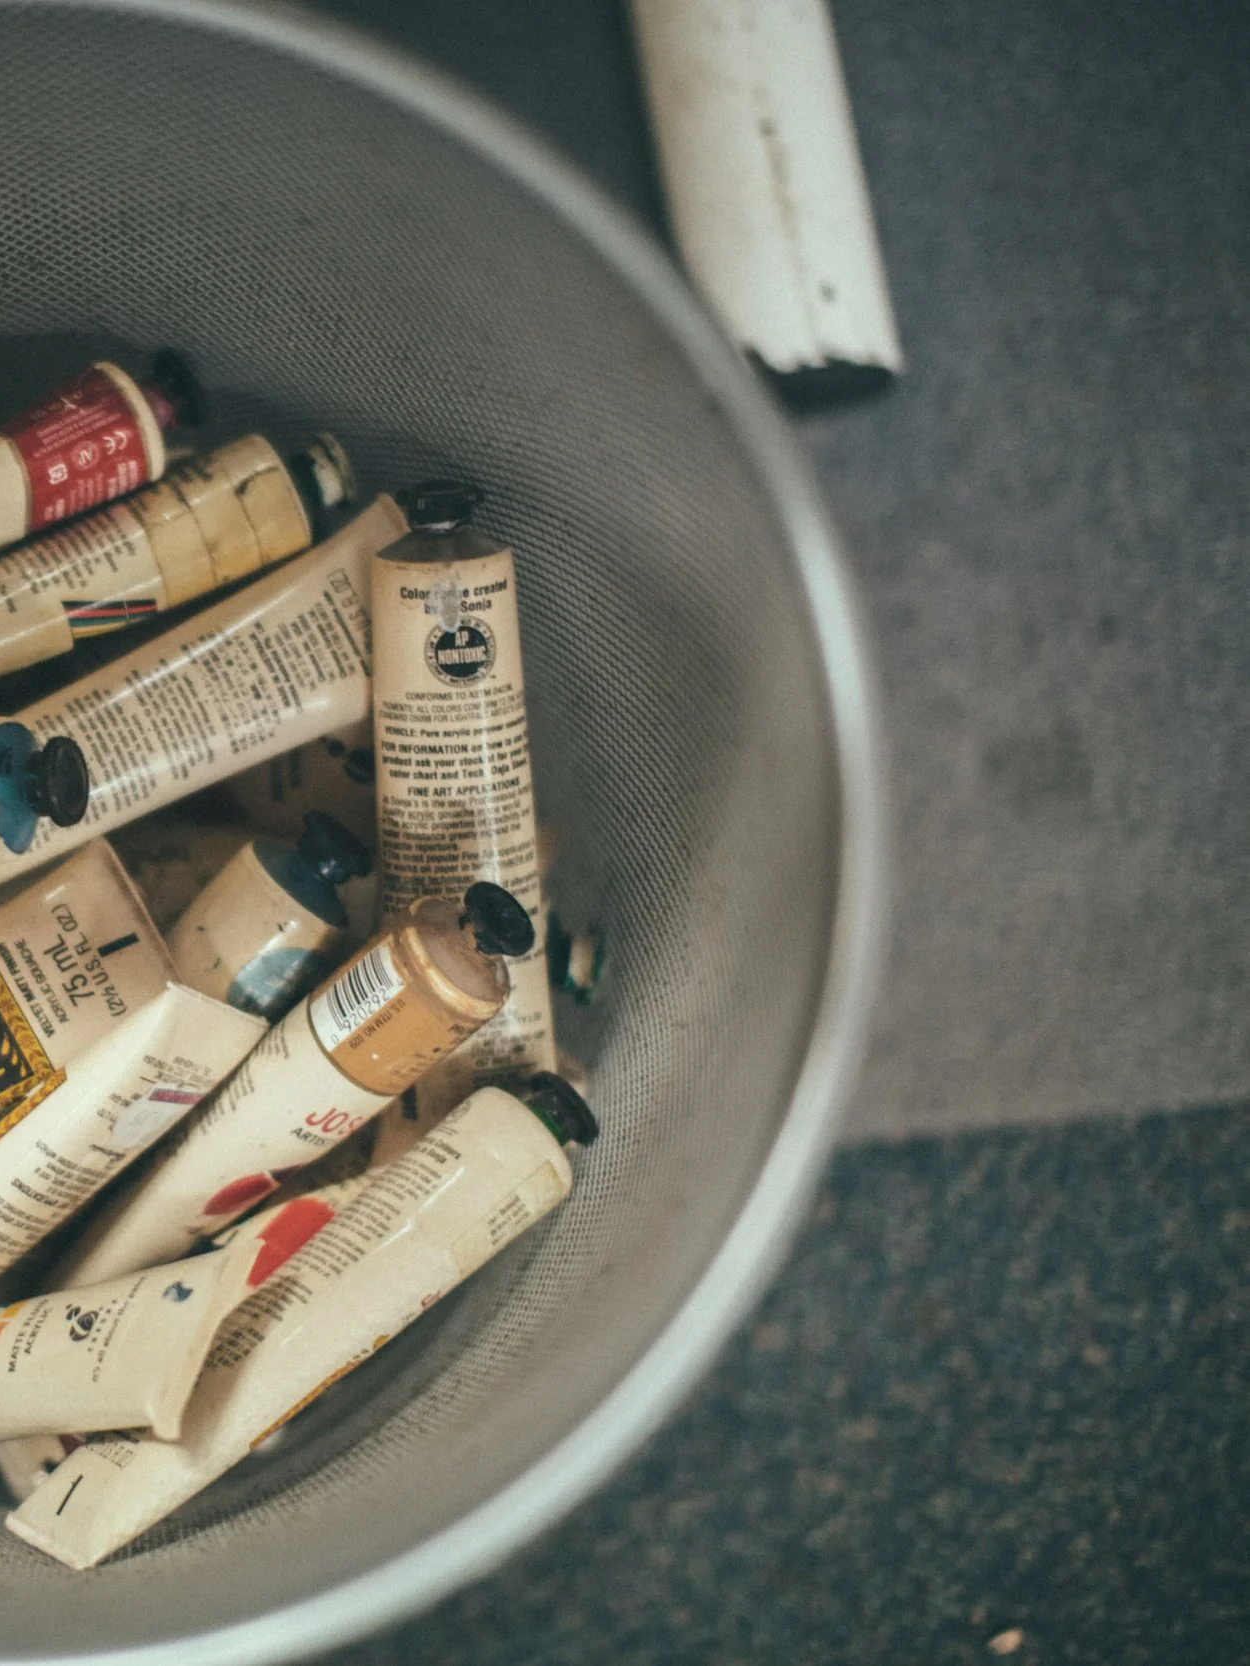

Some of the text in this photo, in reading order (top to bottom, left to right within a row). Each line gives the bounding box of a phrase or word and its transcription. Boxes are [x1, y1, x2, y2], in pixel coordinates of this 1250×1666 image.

[401, 587, 430, 599] Color
[474, 579, 507, 596] created
[460, 599, 492, 612] Sonja
[455, 631, 469, 646] AP
[437, 645, 488, 665] NONTOXIC
[406, 692, 451, 701] CONFORMS
[456, 691, 466, 699] TO
[385, 725, 418, 737] VEHICLE:
[420, 728, 440, 736] Pure
[399, 744, 468, 754] INFORMATION
[415, 757, 431, 767] ask
[434, 758, 455, 769] your
[413, 770, 438, 780] chart
[441, 771, 458, 779] and
[408, 787, 429, 797] FINE
[433, 787, 451, 796] ART
[38, 933, 96, 1007] 75 mL
[82, 954, 109, 986] U.S.
[13, 937, 69, 1024] ACRYLIC GOUACHE
[14, 974, 36, 1003] MATT
[329, 984, 391, 1044] 0 920292
[372, 1008, 392, 1028] ITEM
[8, 1330, 25, 1371] MATTE
